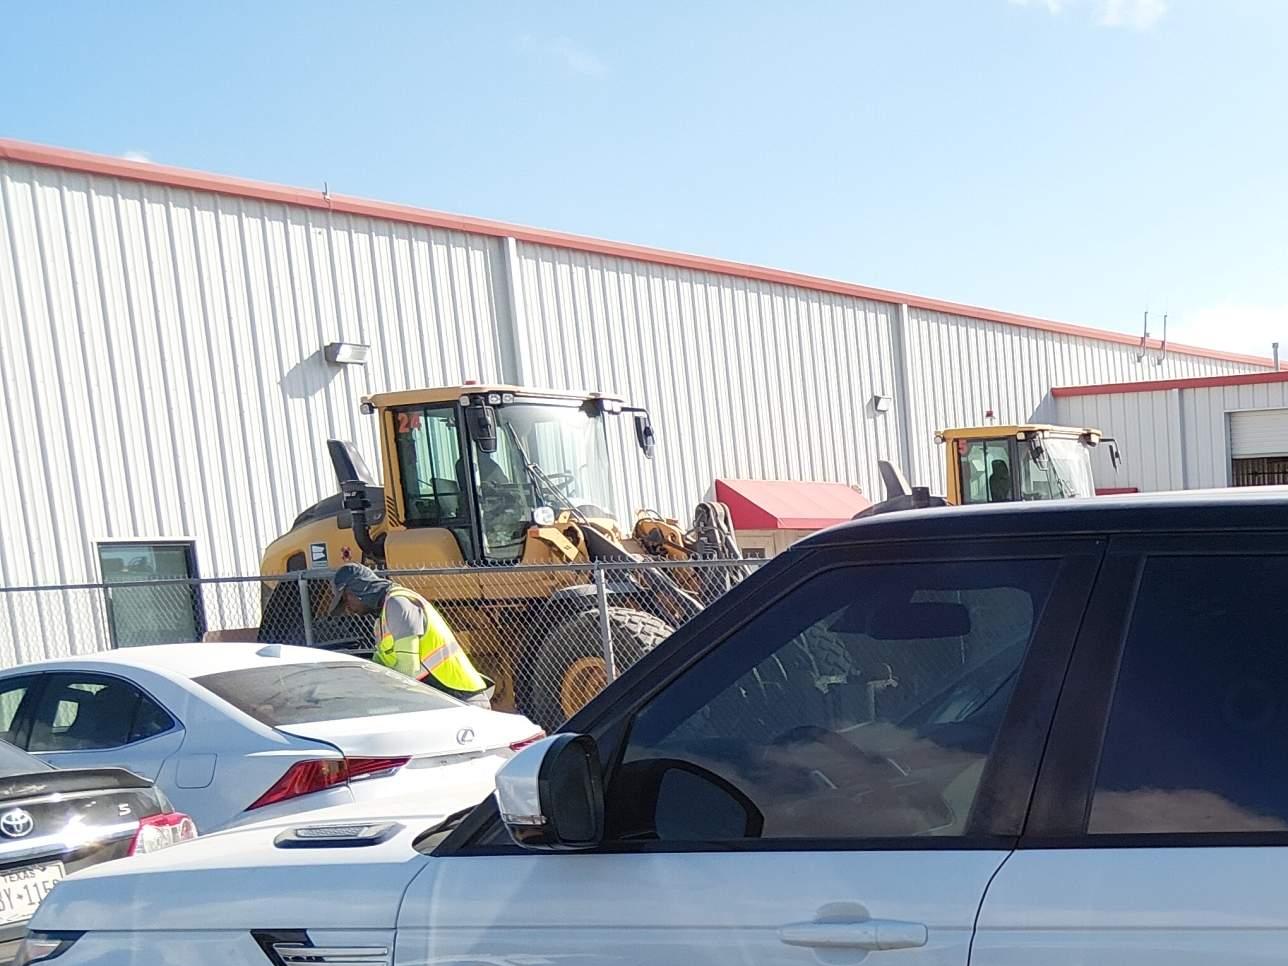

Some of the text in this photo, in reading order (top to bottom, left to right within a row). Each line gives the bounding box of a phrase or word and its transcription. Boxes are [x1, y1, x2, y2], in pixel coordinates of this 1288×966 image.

[398, 412, 422, 432] 24
[118, 803, 131, 816] S
[4, 870, 36, 883] TEXAS
